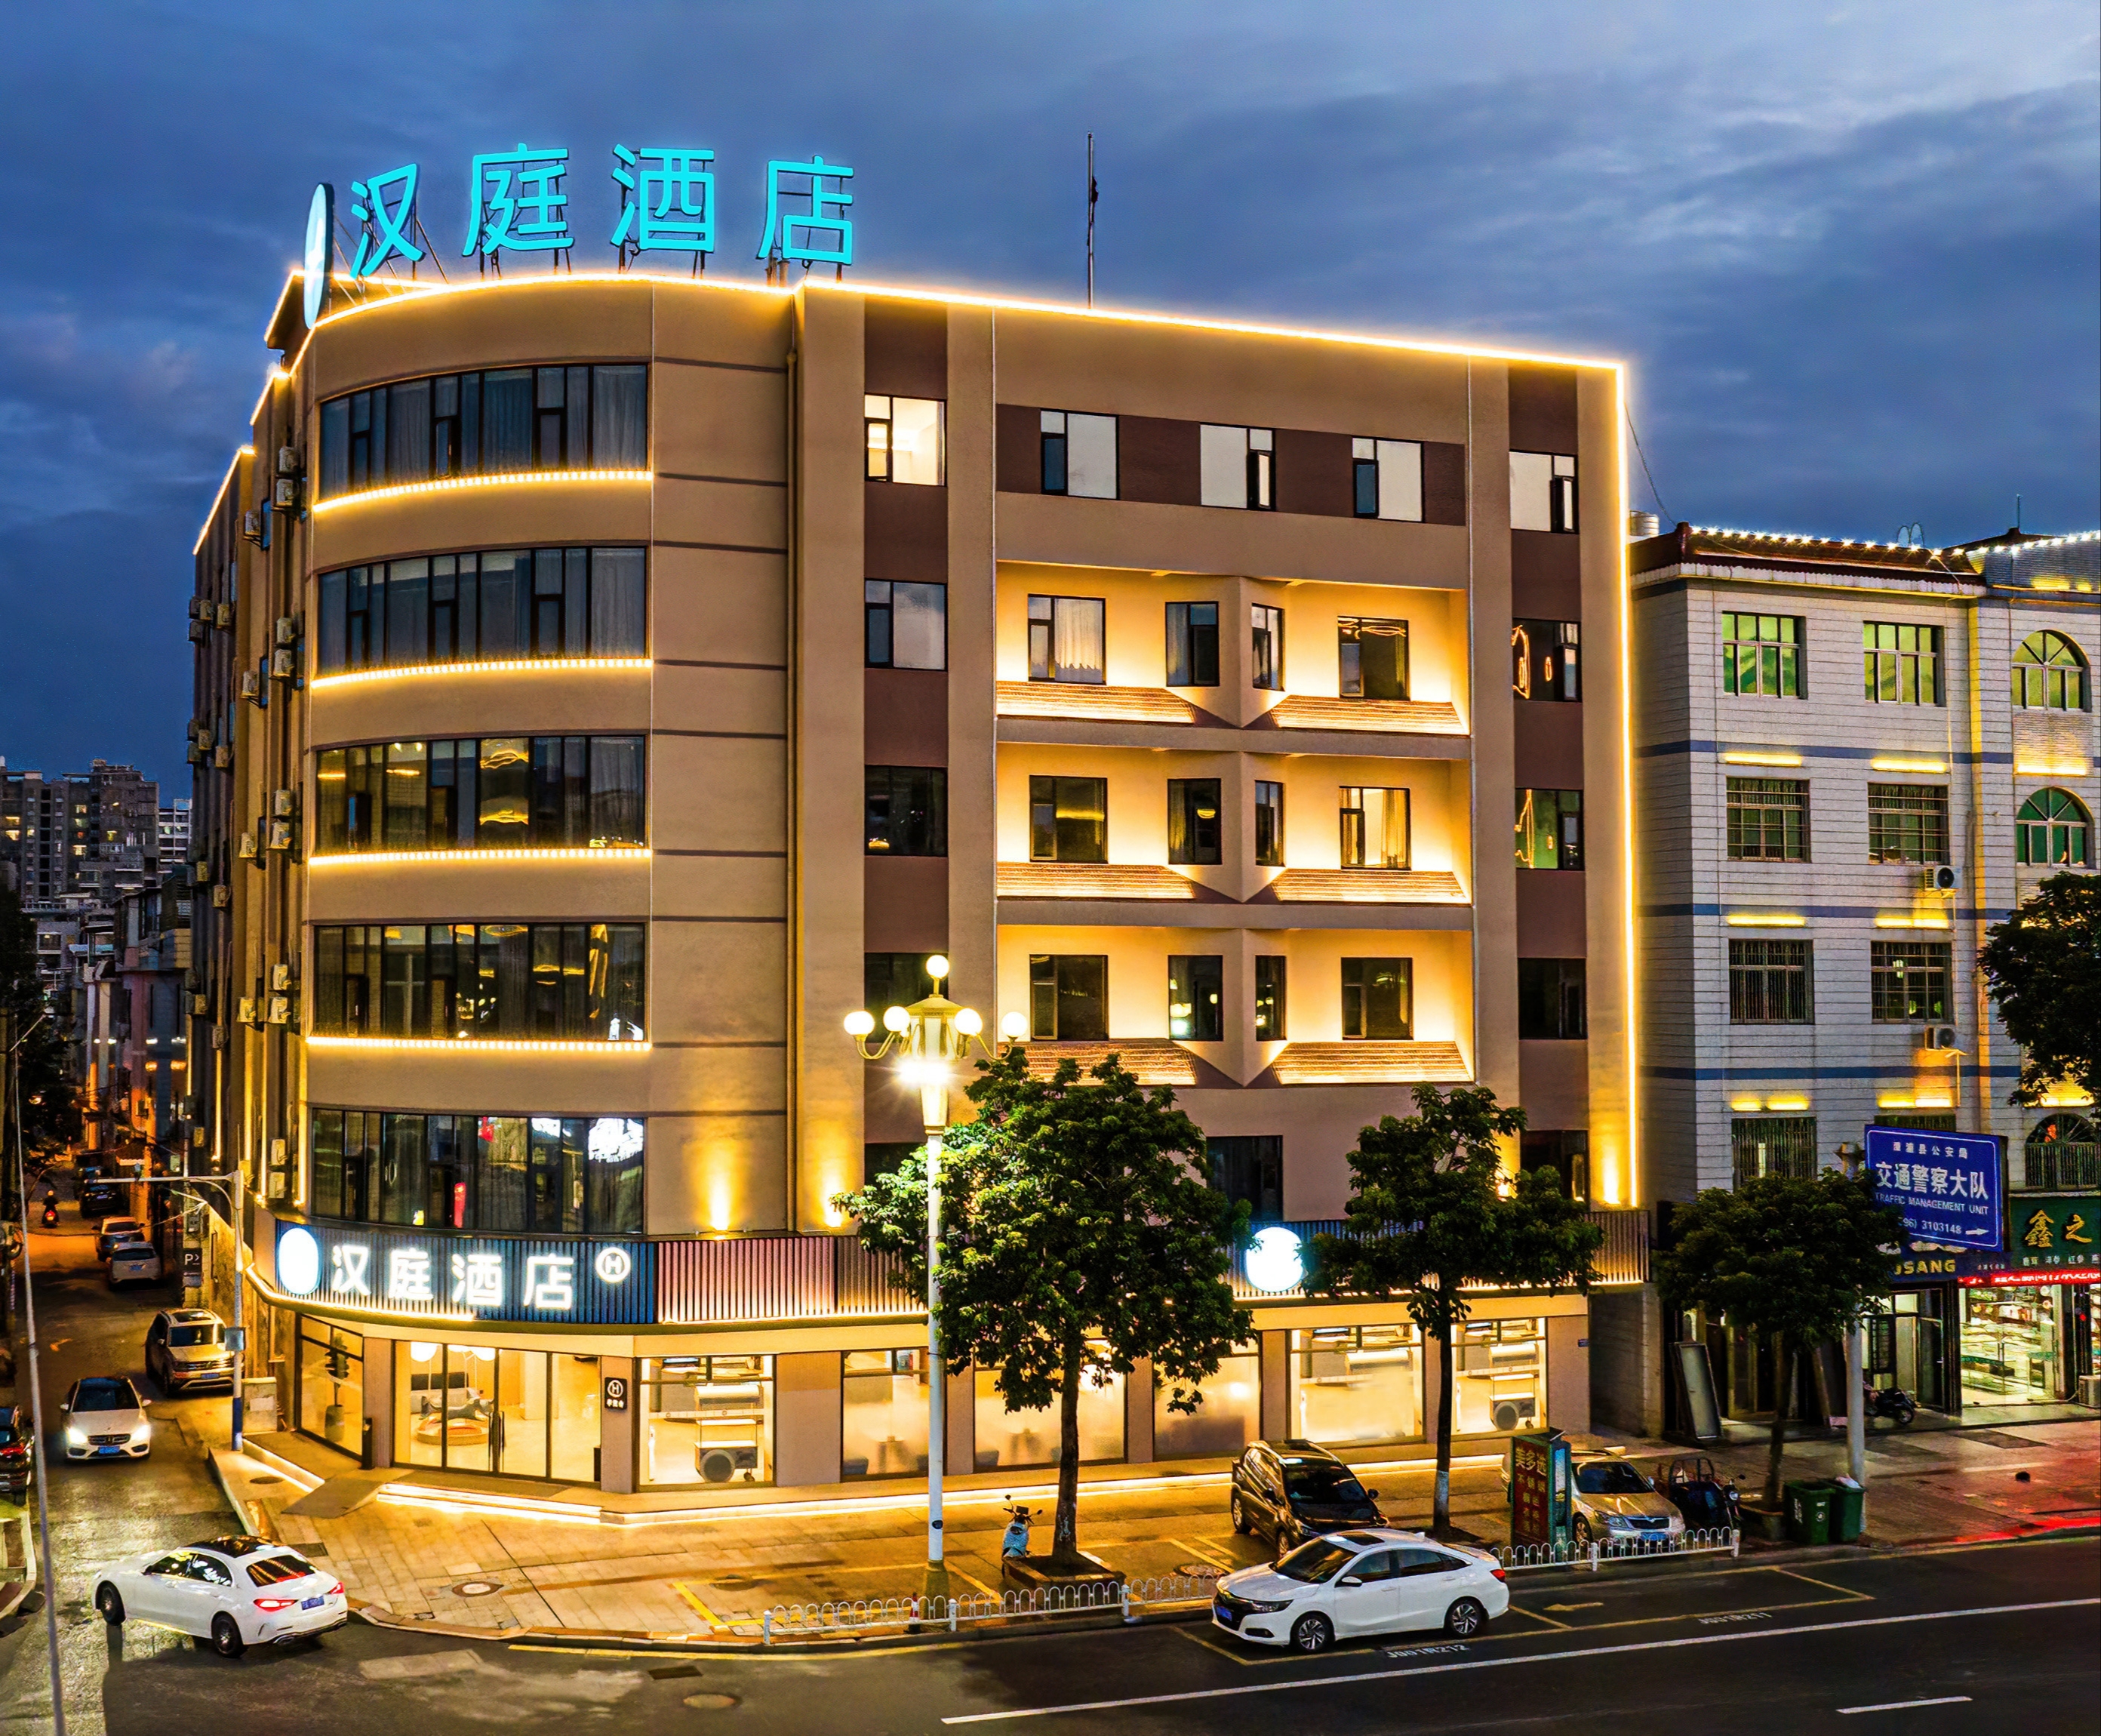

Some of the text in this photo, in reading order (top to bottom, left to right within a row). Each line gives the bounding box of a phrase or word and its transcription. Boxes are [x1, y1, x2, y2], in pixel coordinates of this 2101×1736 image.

[350, 143, 854, 279] 汉庭酒店
[1875, 1161, 1989, 1200] 交通警察大队
[1875, 1192, 1989, 1215] TRAFFIC MANAGEMENT UNIT
[1921, 1220, 1962, 1234] 3103148
[2024, 1209, 2093, 1248] 鑫之
[331, 1244, 574, 1310] 汉庭酒店
